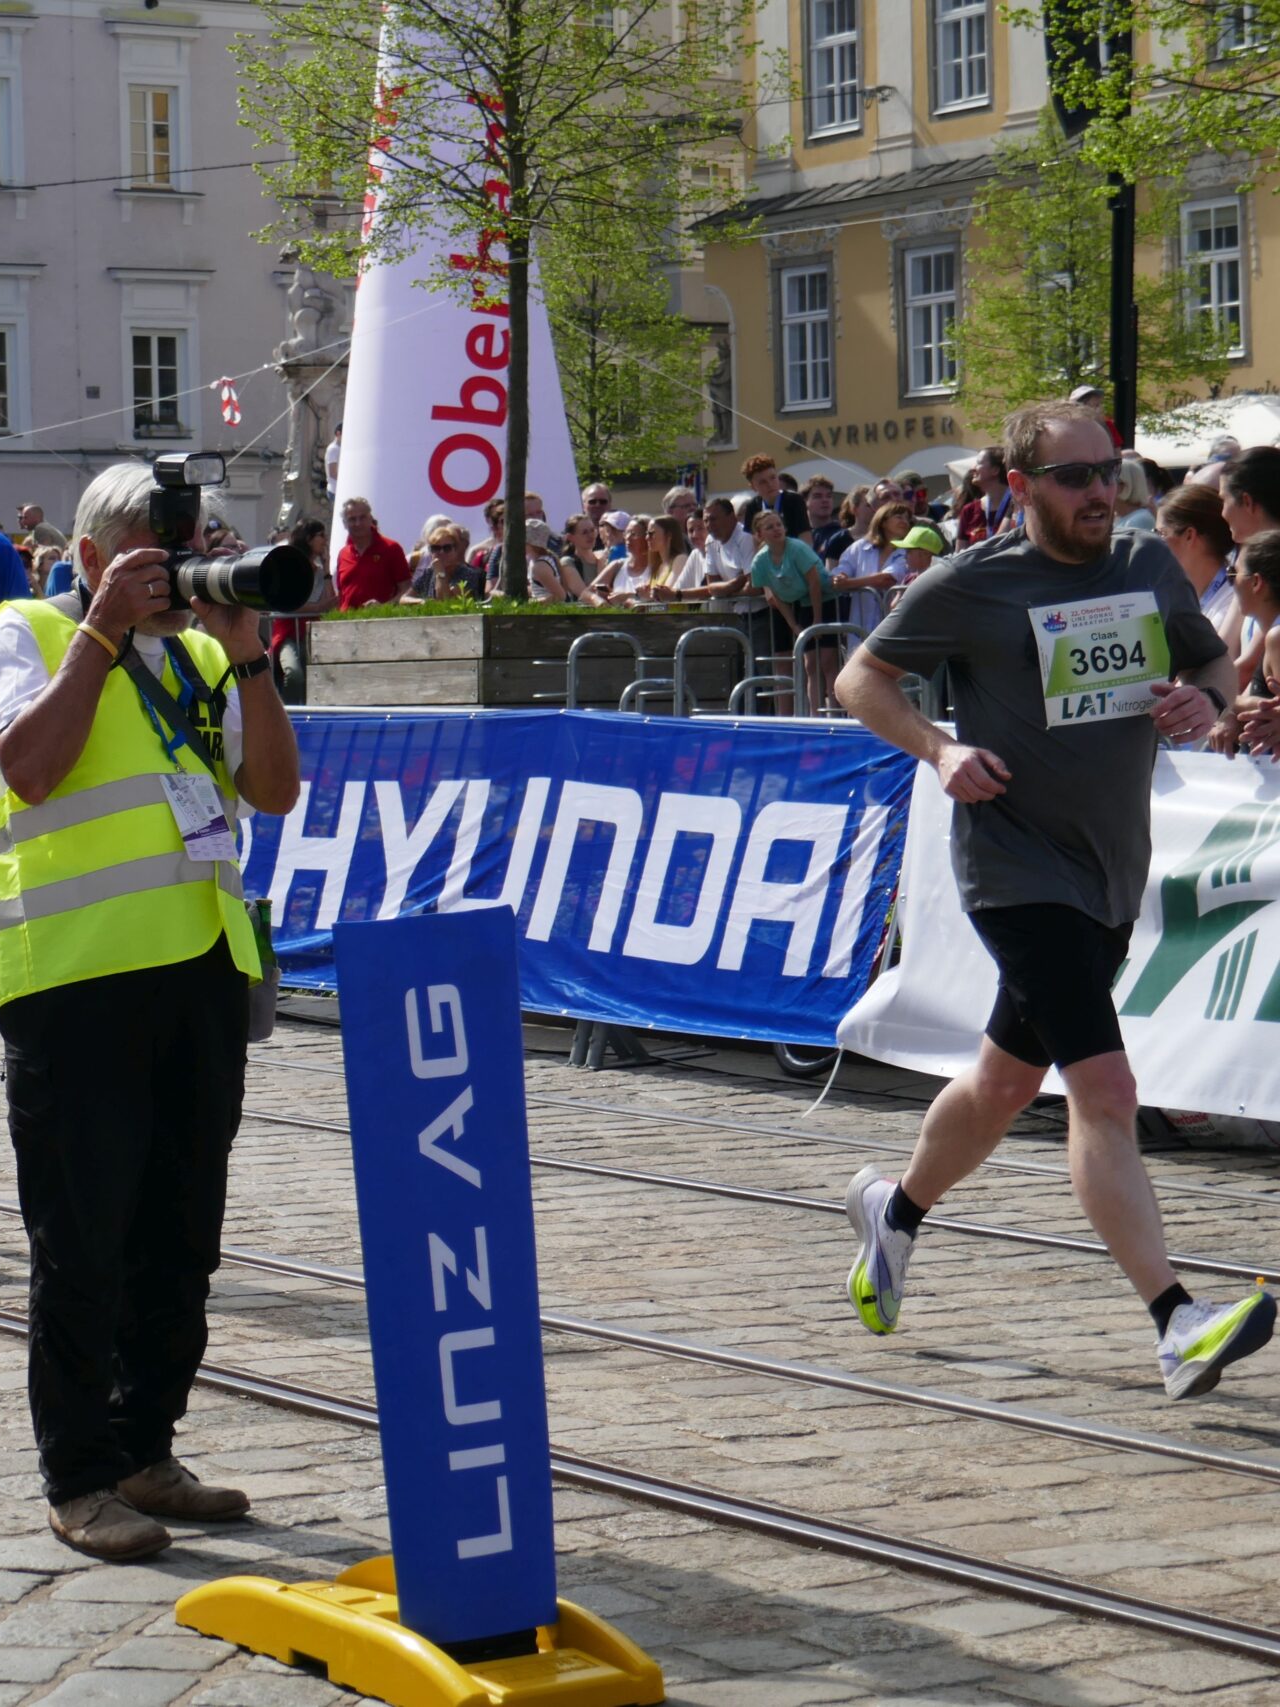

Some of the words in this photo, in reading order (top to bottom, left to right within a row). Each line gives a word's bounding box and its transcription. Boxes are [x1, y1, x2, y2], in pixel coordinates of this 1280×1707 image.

[786, 416, 954, 451] MAYRHOFER
[1091, 631, 1118, 641] Claas
[1069, 640, 1146, 676] 3694
[1062, 692, 1108, 719] LAT
[264, 777, 895, 979] HYUNDAI
[405, 983, 481, 1189] AG
[428, 1226, 514, 1560] LINZ
